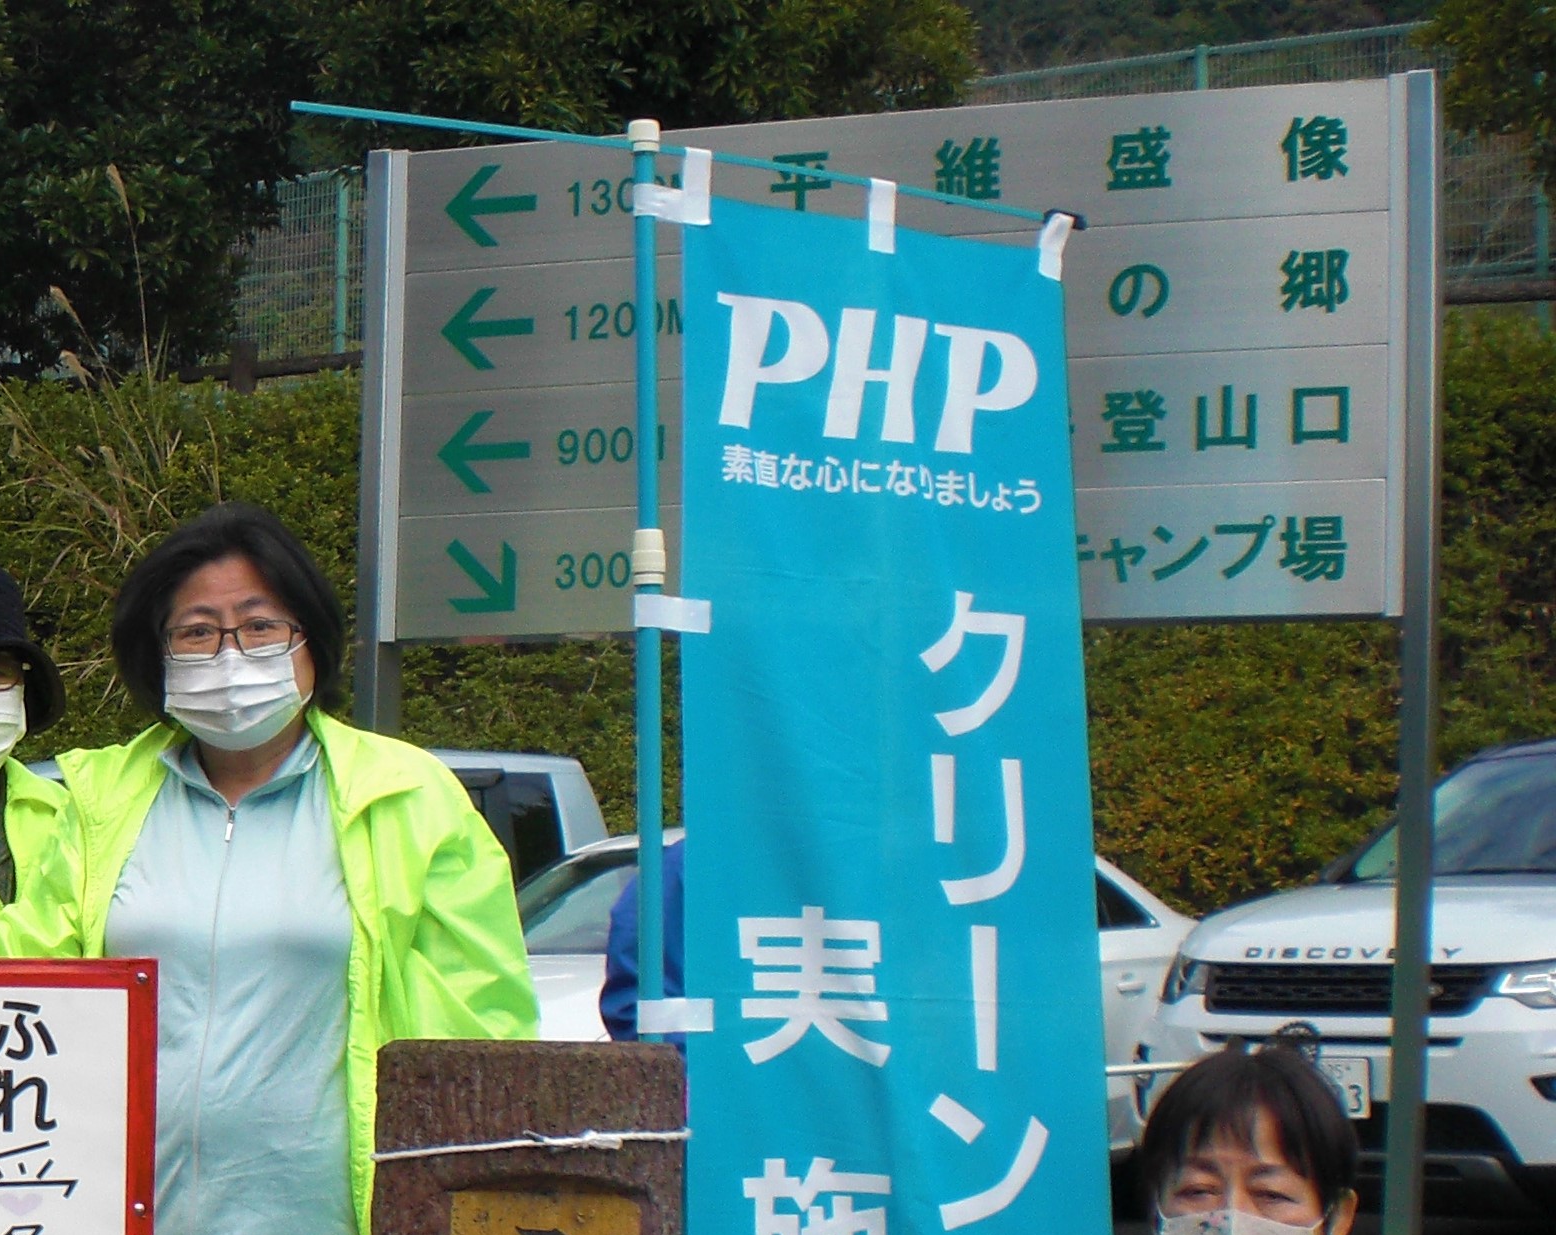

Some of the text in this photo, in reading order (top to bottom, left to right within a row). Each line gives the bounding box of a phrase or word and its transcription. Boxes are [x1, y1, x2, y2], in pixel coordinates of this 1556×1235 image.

[567, 115, 1349, 216] 130 平維盛像
[565, 298, 683, 341] 120M
[717, 291, 1038, 454] PHP
[1069, 384, 1350, 452] 登山口
[720, 443, 1042, 515] 素直な心になりましょう
[555, 552, 631, 590] 300
